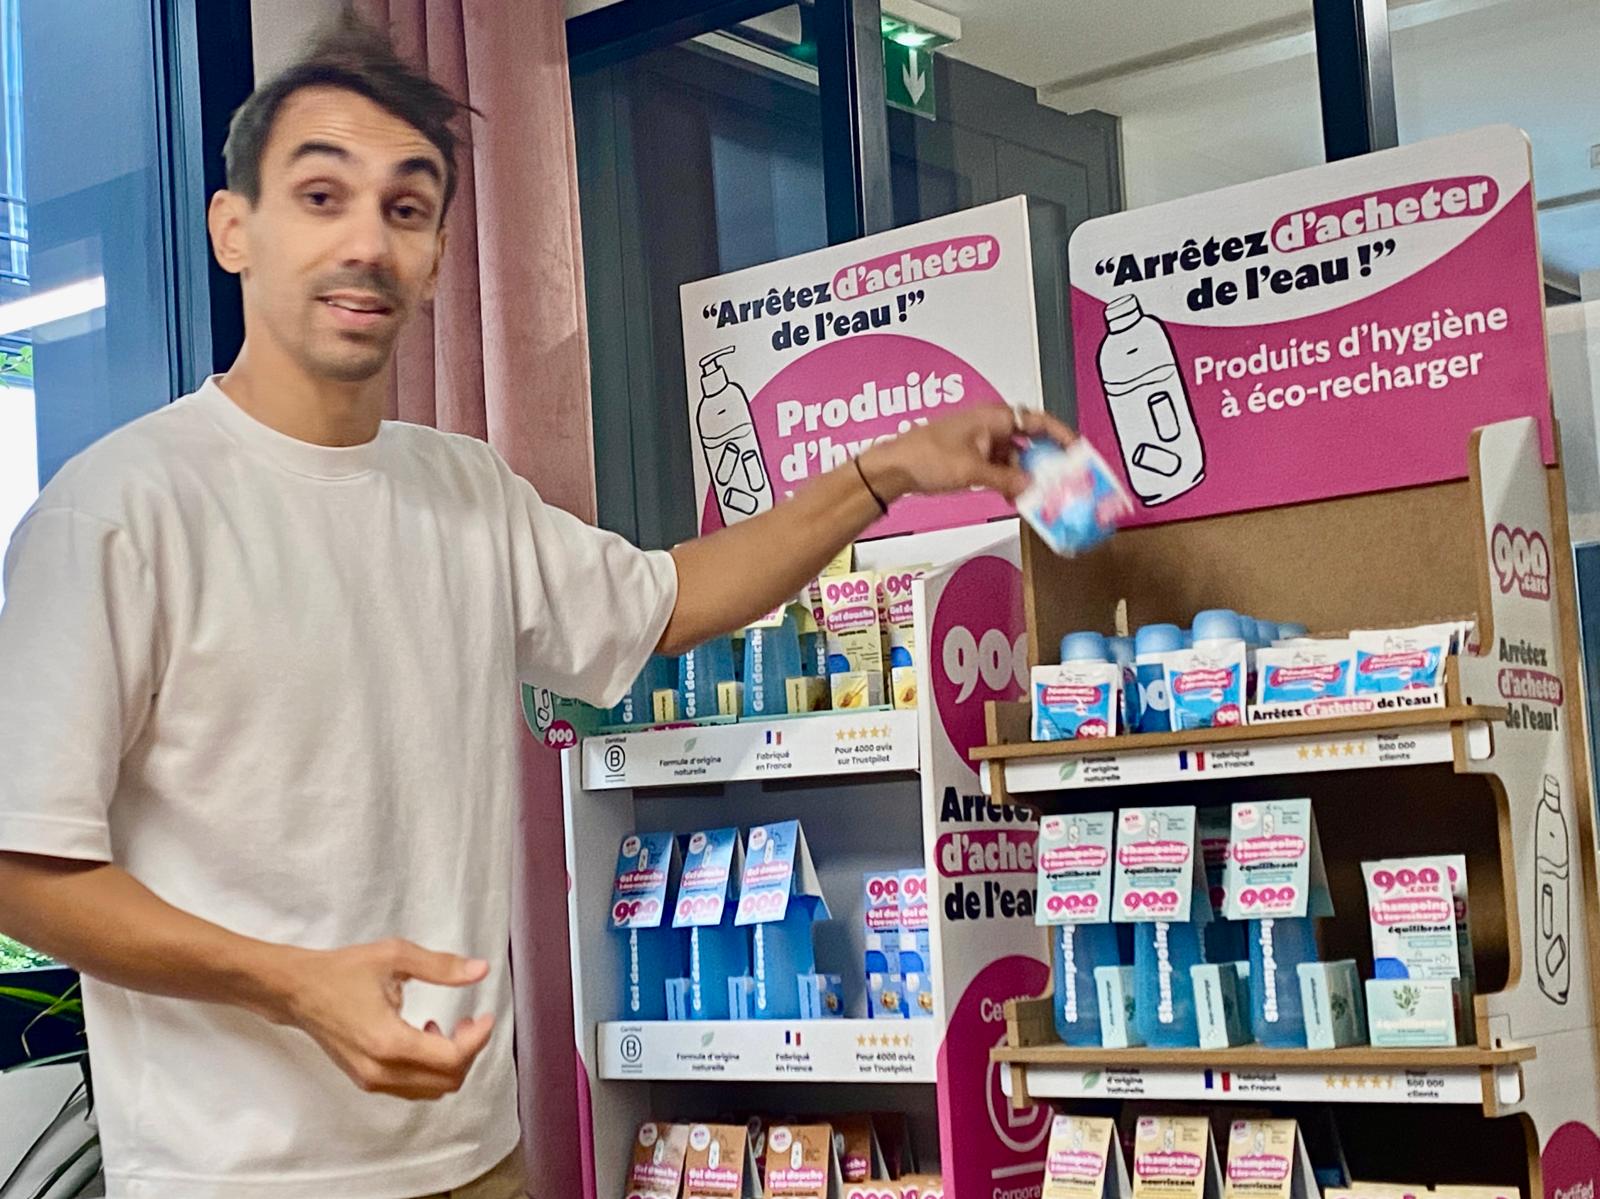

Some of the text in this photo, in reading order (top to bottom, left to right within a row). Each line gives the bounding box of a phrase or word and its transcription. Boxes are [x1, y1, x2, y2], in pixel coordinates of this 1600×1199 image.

[1095, 229, 1268, 286] “Arrêtez
[1186, 277, 1238, 312] de
[1245, 256, 1349, 300] l’eau
[702, 281, 832, 329] “Arrêtez
[771, 321, 810, 351] de
[815, 305, 892, 341] l’eau
[1194, 306, 1508, 385] Produits d’hygiène
[1220, 349, 1484, 419] à éco-recharger
[776, 371, 965, 438] Produits
[1493, 525, 1549, 589] 900
[826, 579, 870, 605] 900
[887, 573, 912, 598] 90
[622, 698, 634, 723] Gel
[685, 692, 696, 718] Gel
[752, 685, 764, 713] Gel
[1377, 697, 1394, 709] de
[548, 728, 573, 746] 900
[855, 744, 874, 753] 4000
[766, 762, 792, 771] France
[1374, 868, 1441, 893] 900
[679, 897, 720, 918] 900
[742, 892, 784, 914] 900
[945, 882, 981, 920] de
[1047, 894, 1098, 914] 900
[1124, 891, 1179, 911] 900
[1240, 887, 1295, 909] 900
[615, 900, 658, 922] 900
